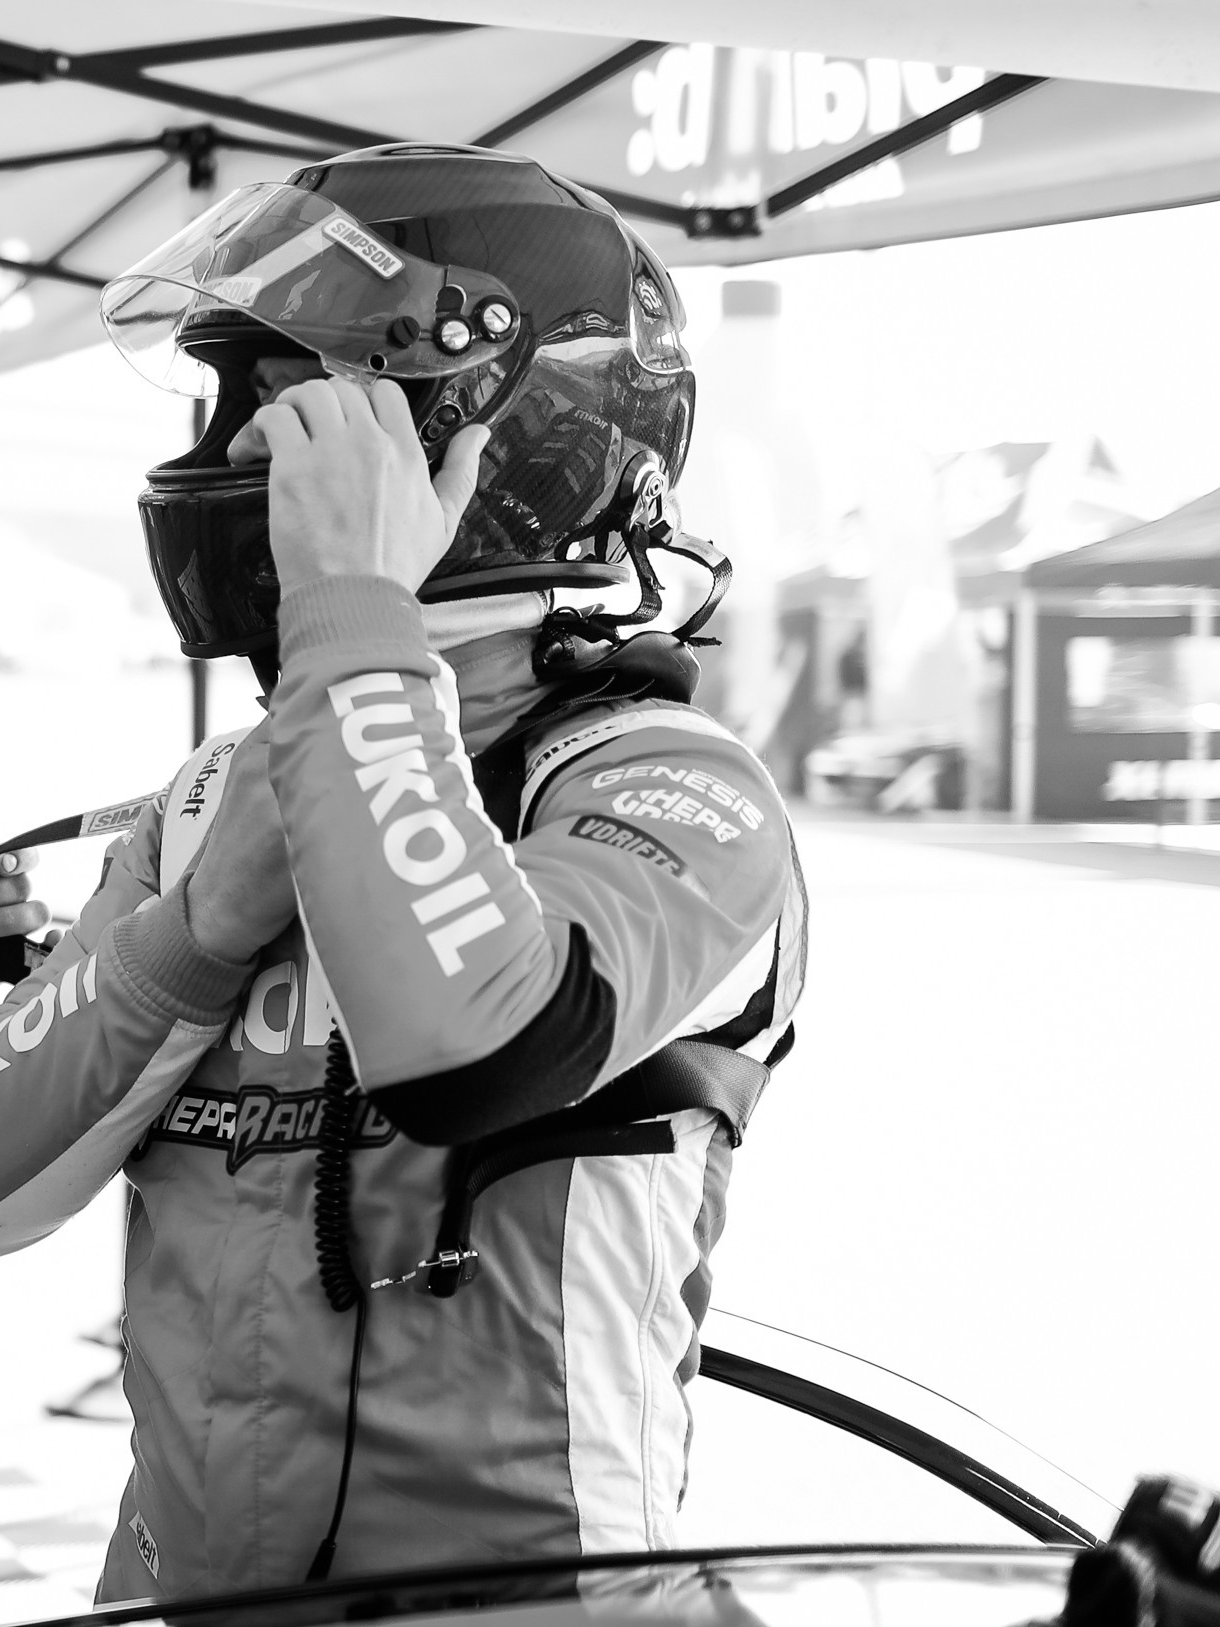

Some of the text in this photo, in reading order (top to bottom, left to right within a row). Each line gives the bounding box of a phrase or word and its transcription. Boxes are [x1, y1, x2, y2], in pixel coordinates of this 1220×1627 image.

[330, 222, 395, 273] SIMPSON
[180, 742, 236, 818] Sabelt
[592, 765, 765, 831] GENESIS
[327, 672, 507, 978] LUKOIL
